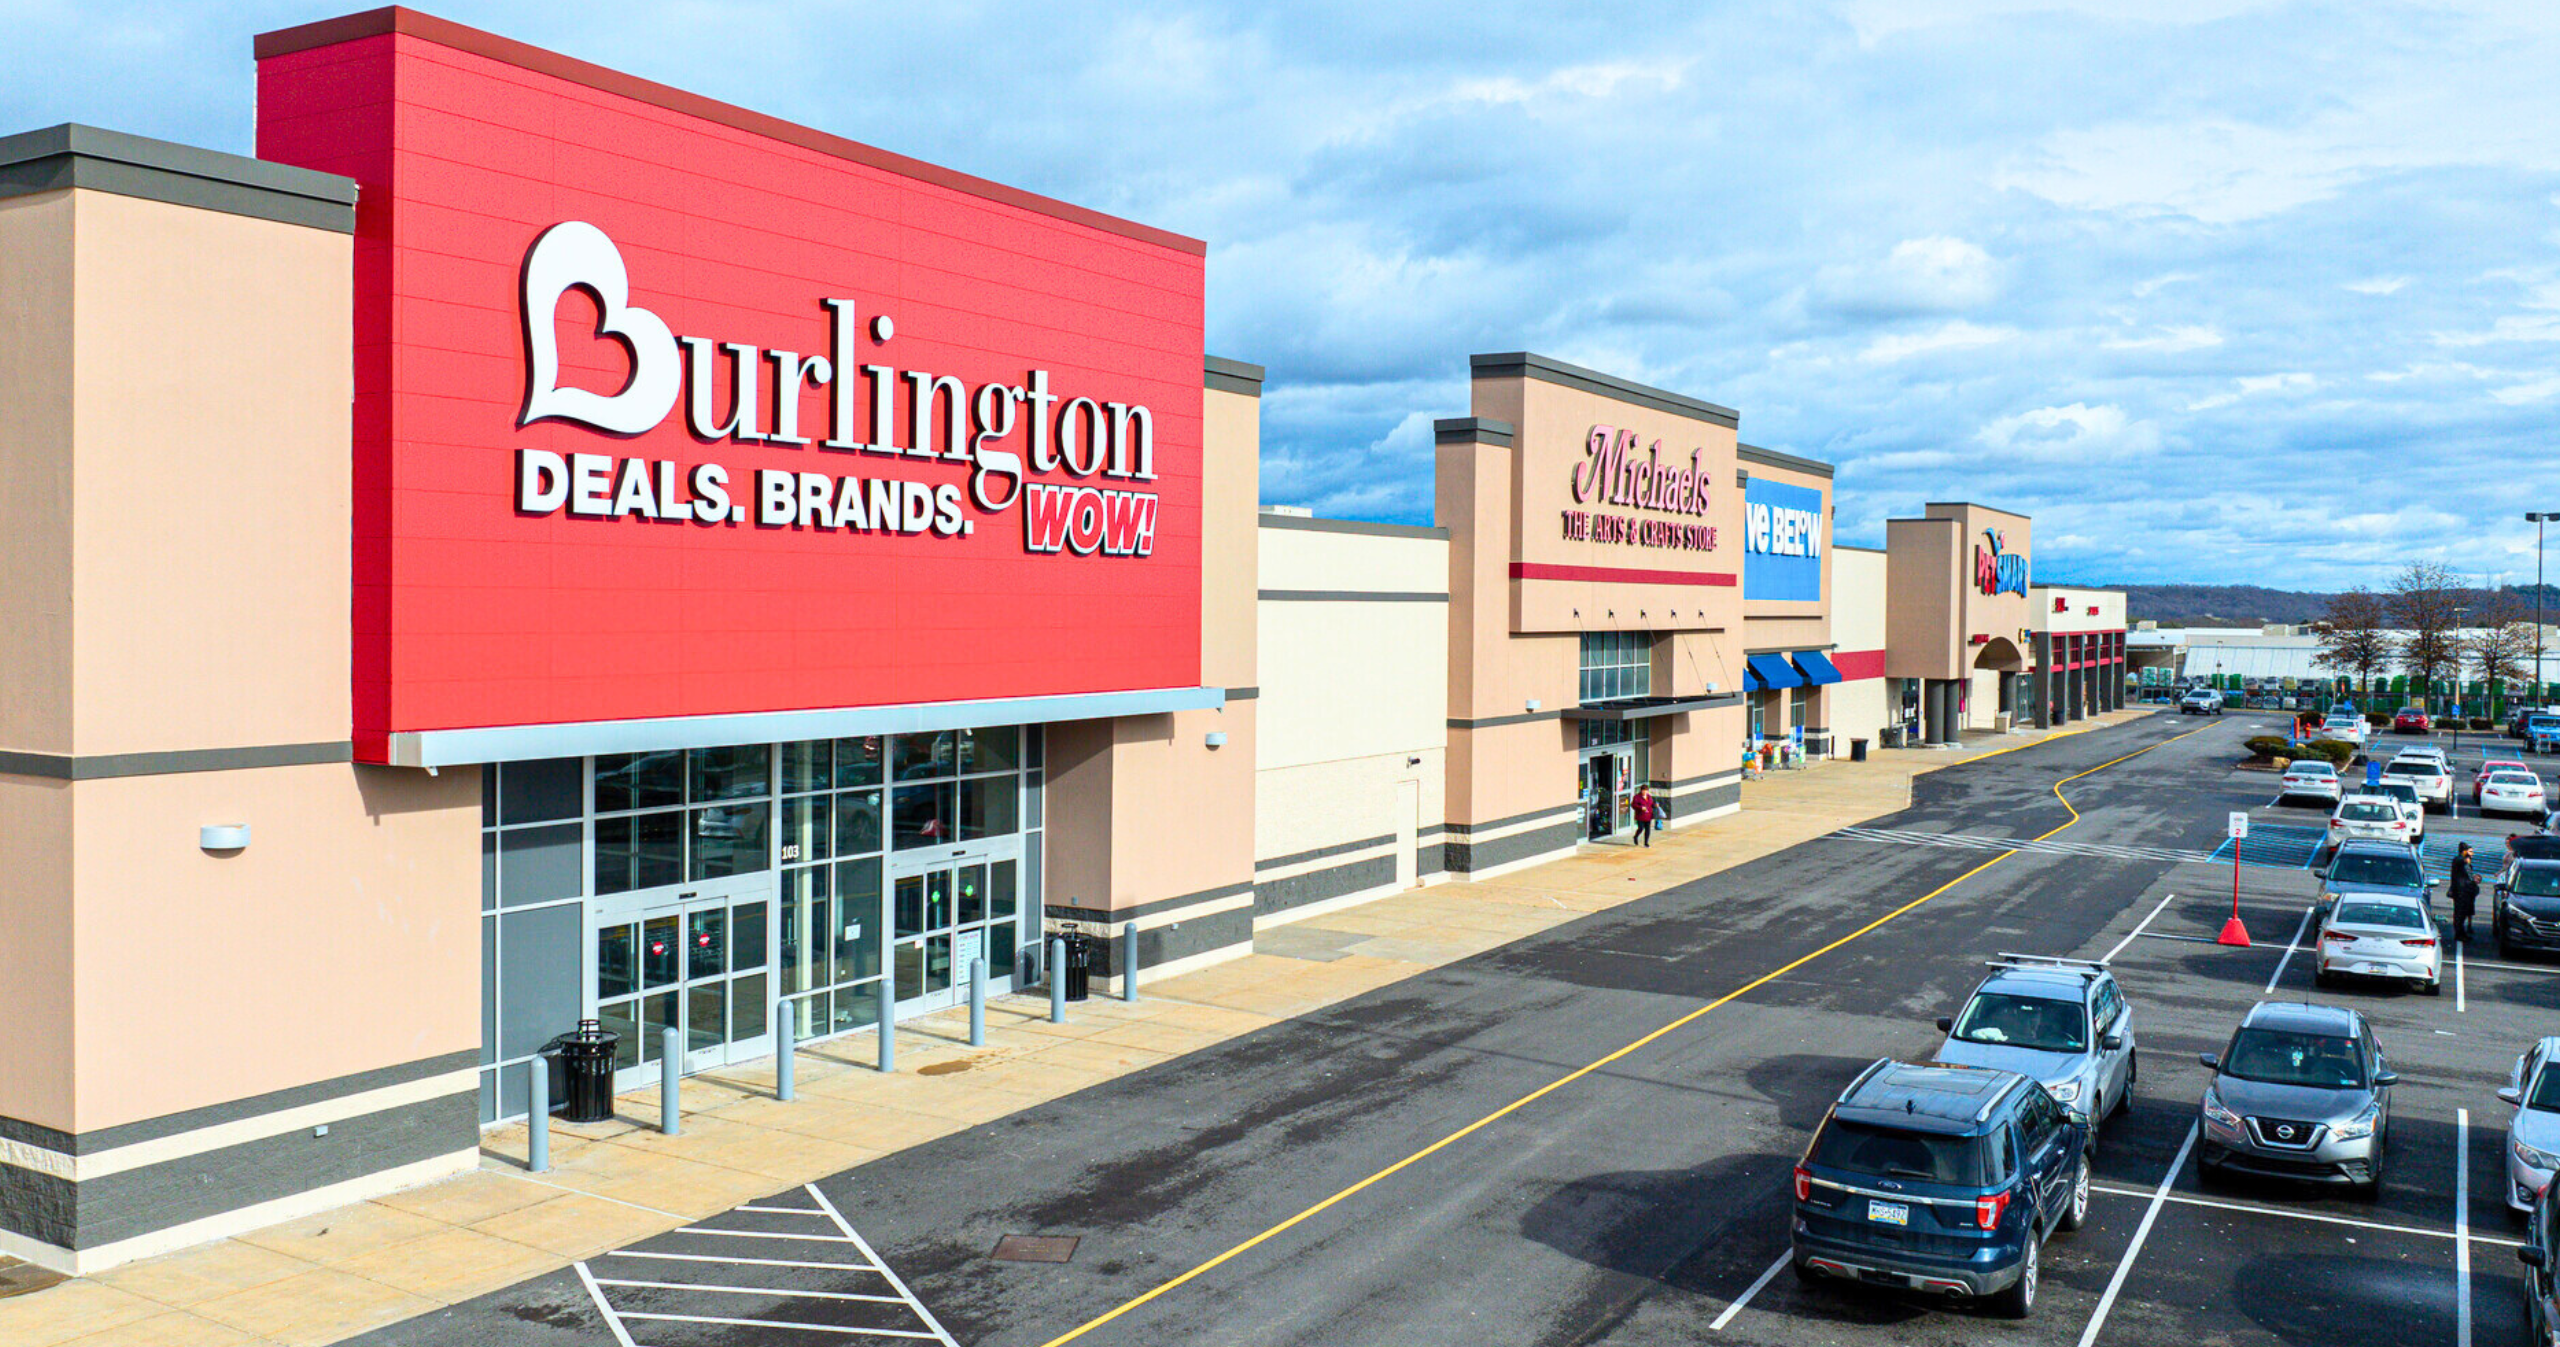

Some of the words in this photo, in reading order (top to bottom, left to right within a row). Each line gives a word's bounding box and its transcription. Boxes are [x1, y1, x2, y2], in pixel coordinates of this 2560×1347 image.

[520, 220, 1158, 511] Burlington
[519, 449, 745, 523] DEALS.
[759, 470, 975, 536] BRANDS.
[1573, 424, 1711, 515] Michaels
[1025, 483, 1159, 556] WOW!
[1563, 510, 1590, 540] THE
[1594, 514, 1625, 543] ARTS
[1628, 518, 1638, 544] &
[1642, 520, 1683, 548] CRAFTS
[1686, 525, 1718, 551] STORE
[782, 845, 799, 860] 103
